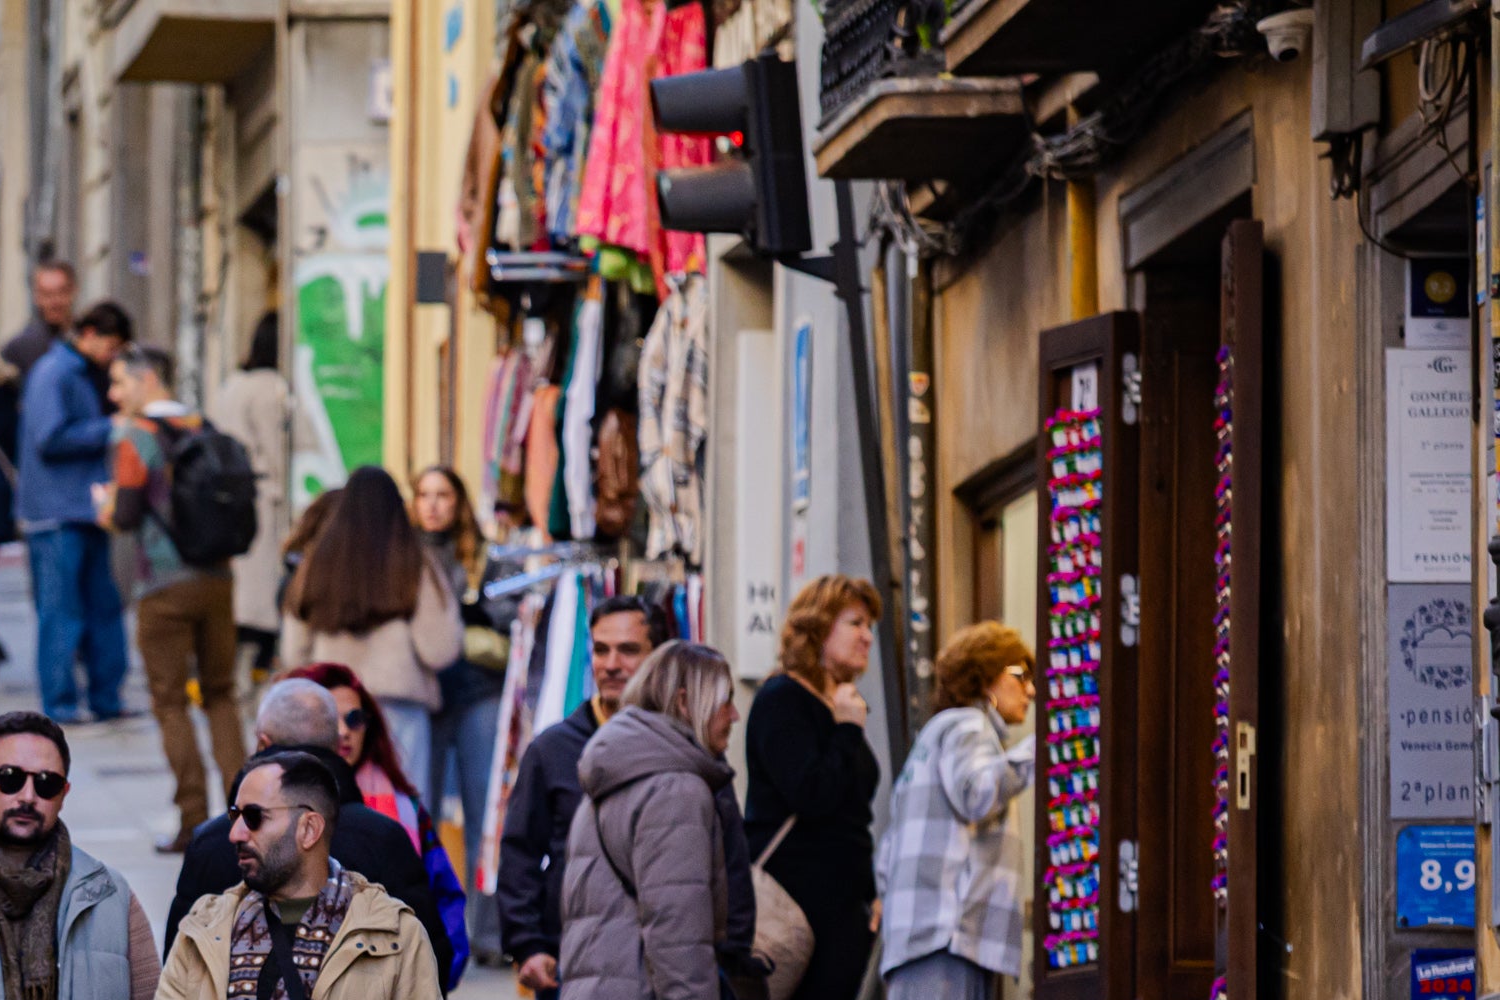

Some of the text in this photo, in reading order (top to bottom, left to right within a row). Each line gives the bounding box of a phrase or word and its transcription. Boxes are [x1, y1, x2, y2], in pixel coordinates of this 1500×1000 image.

[1415, 551, 1471, 563] PENSIÓN
[1400, 741, 1442, 751] Venecia
[1420, 859, 1475, 893] 8,9
[1431, 958, 1475, 976] Routard
[1420, 978, 1473, 994] 2024
